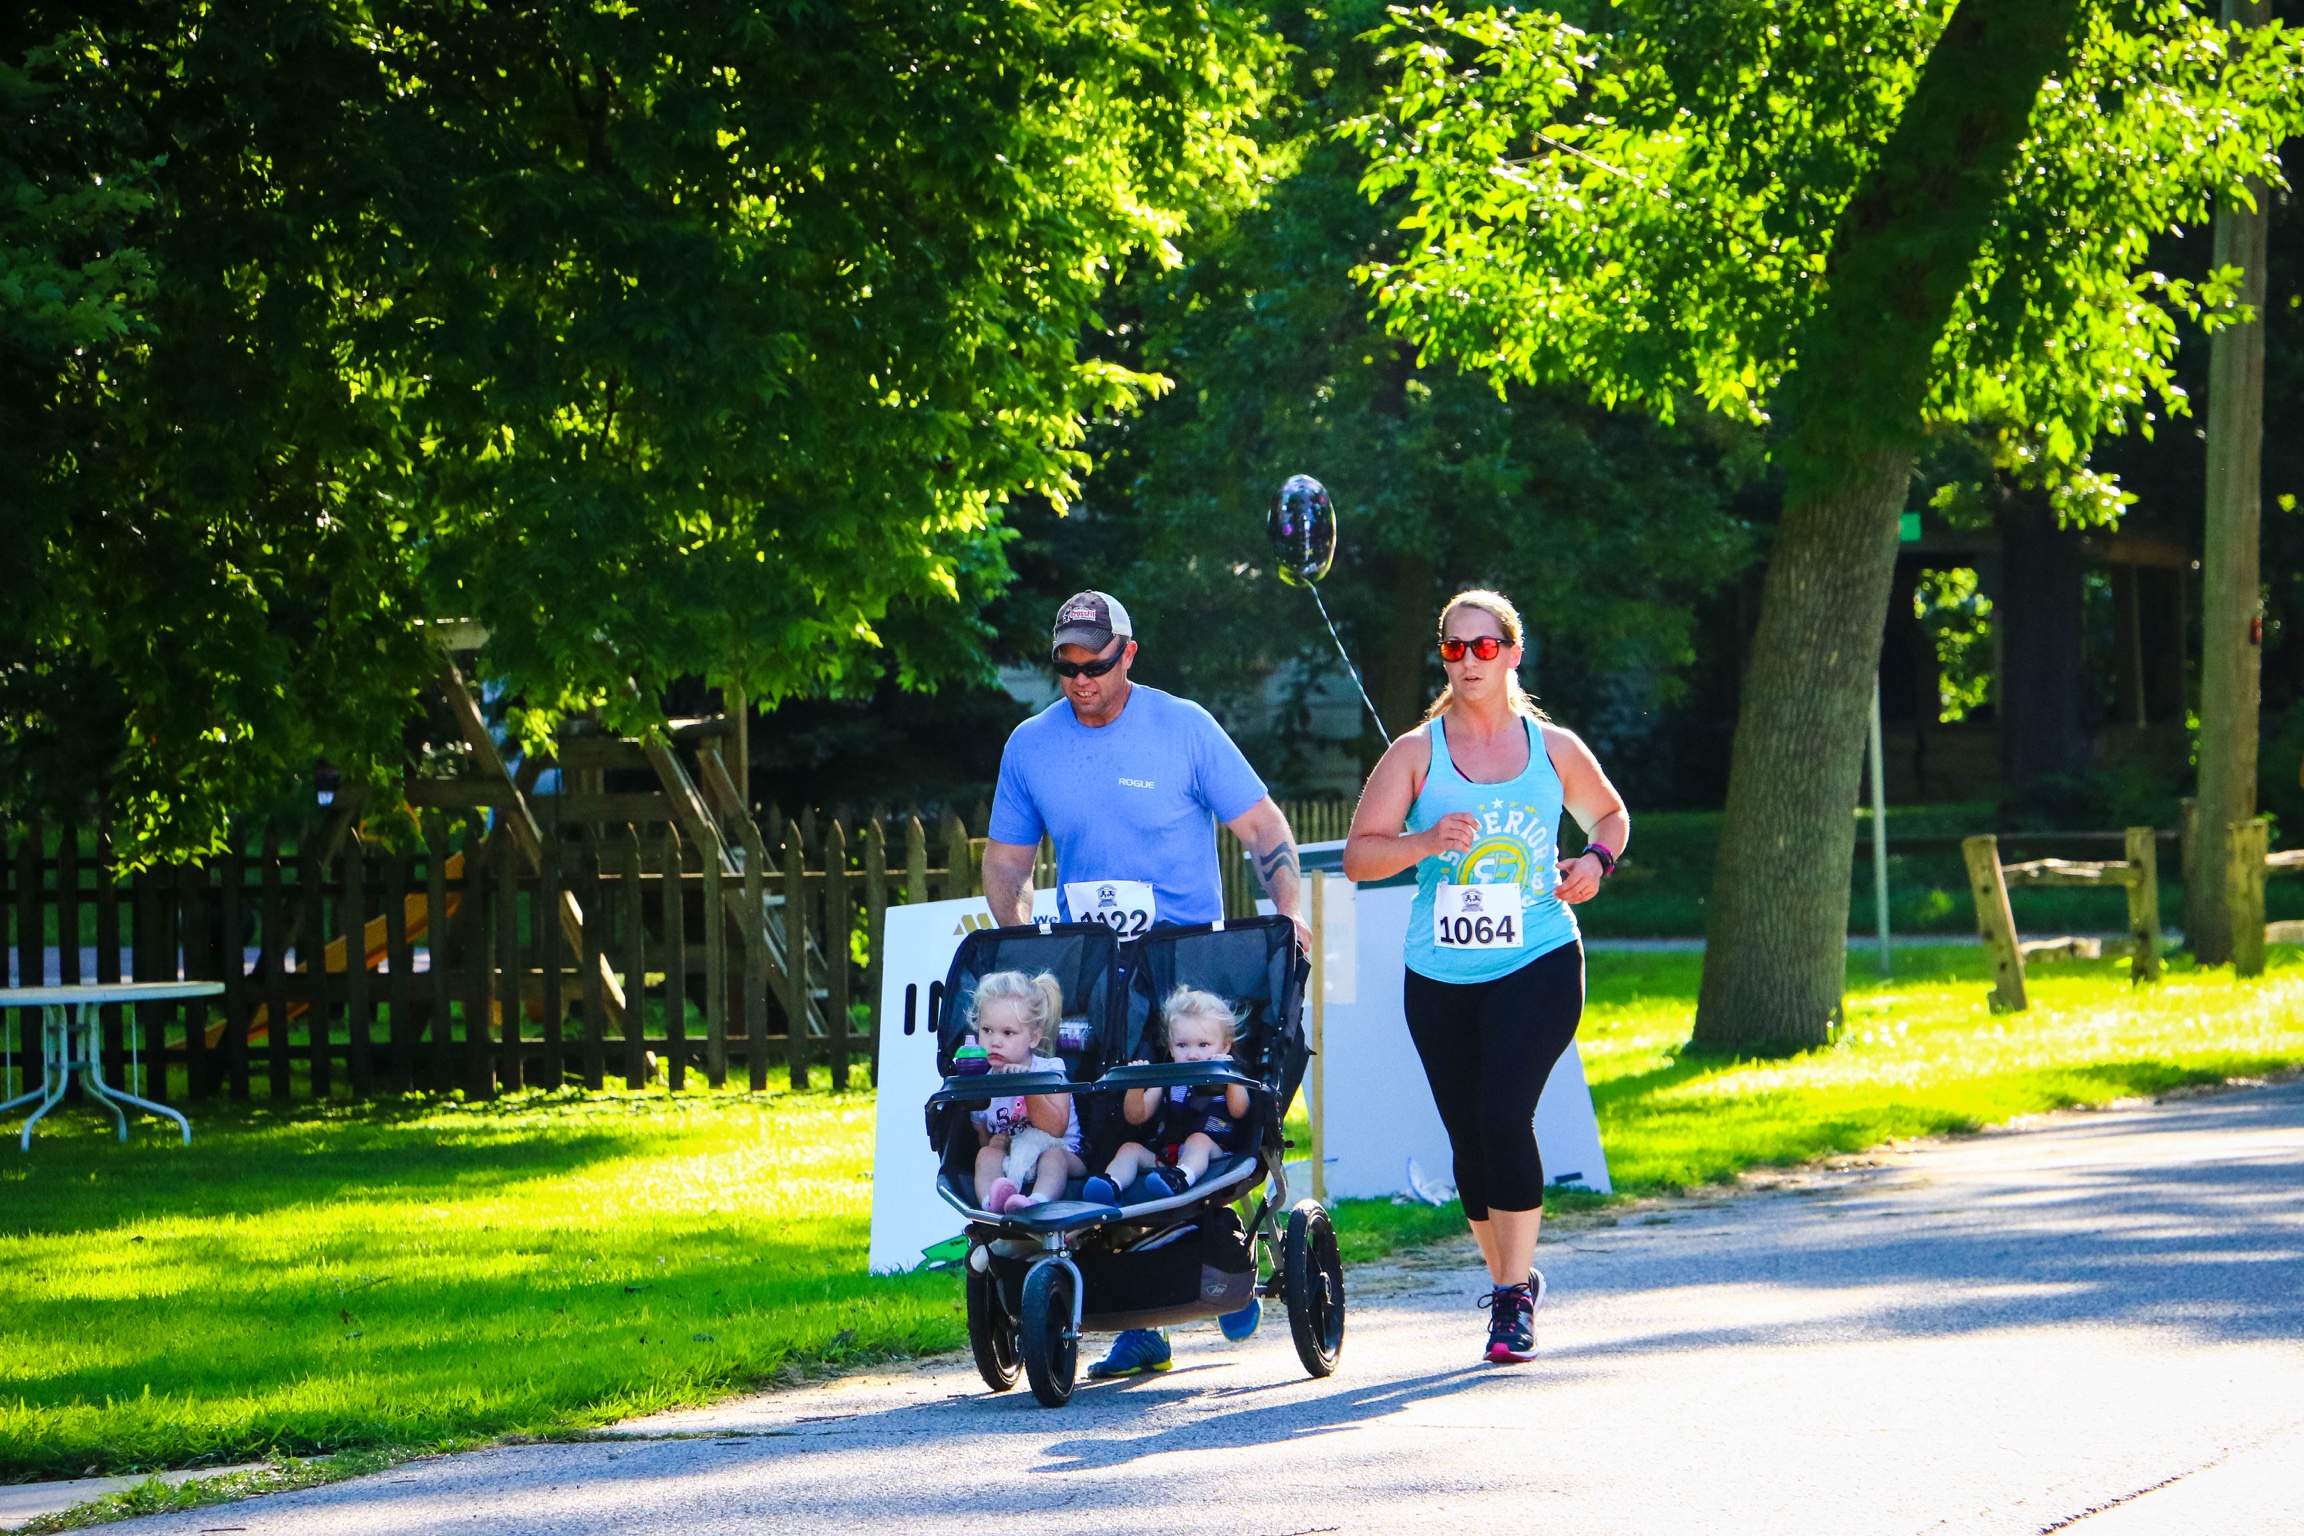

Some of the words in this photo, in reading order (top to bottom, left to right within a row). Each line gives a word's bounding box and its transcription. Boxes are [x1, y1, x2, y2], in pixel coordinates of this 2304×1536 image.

[1118, 777, 1155, 789] ROGUE
[1439, 811, 1549, 866] SERIOR
[1440, 915, 1516, 944] 1064
